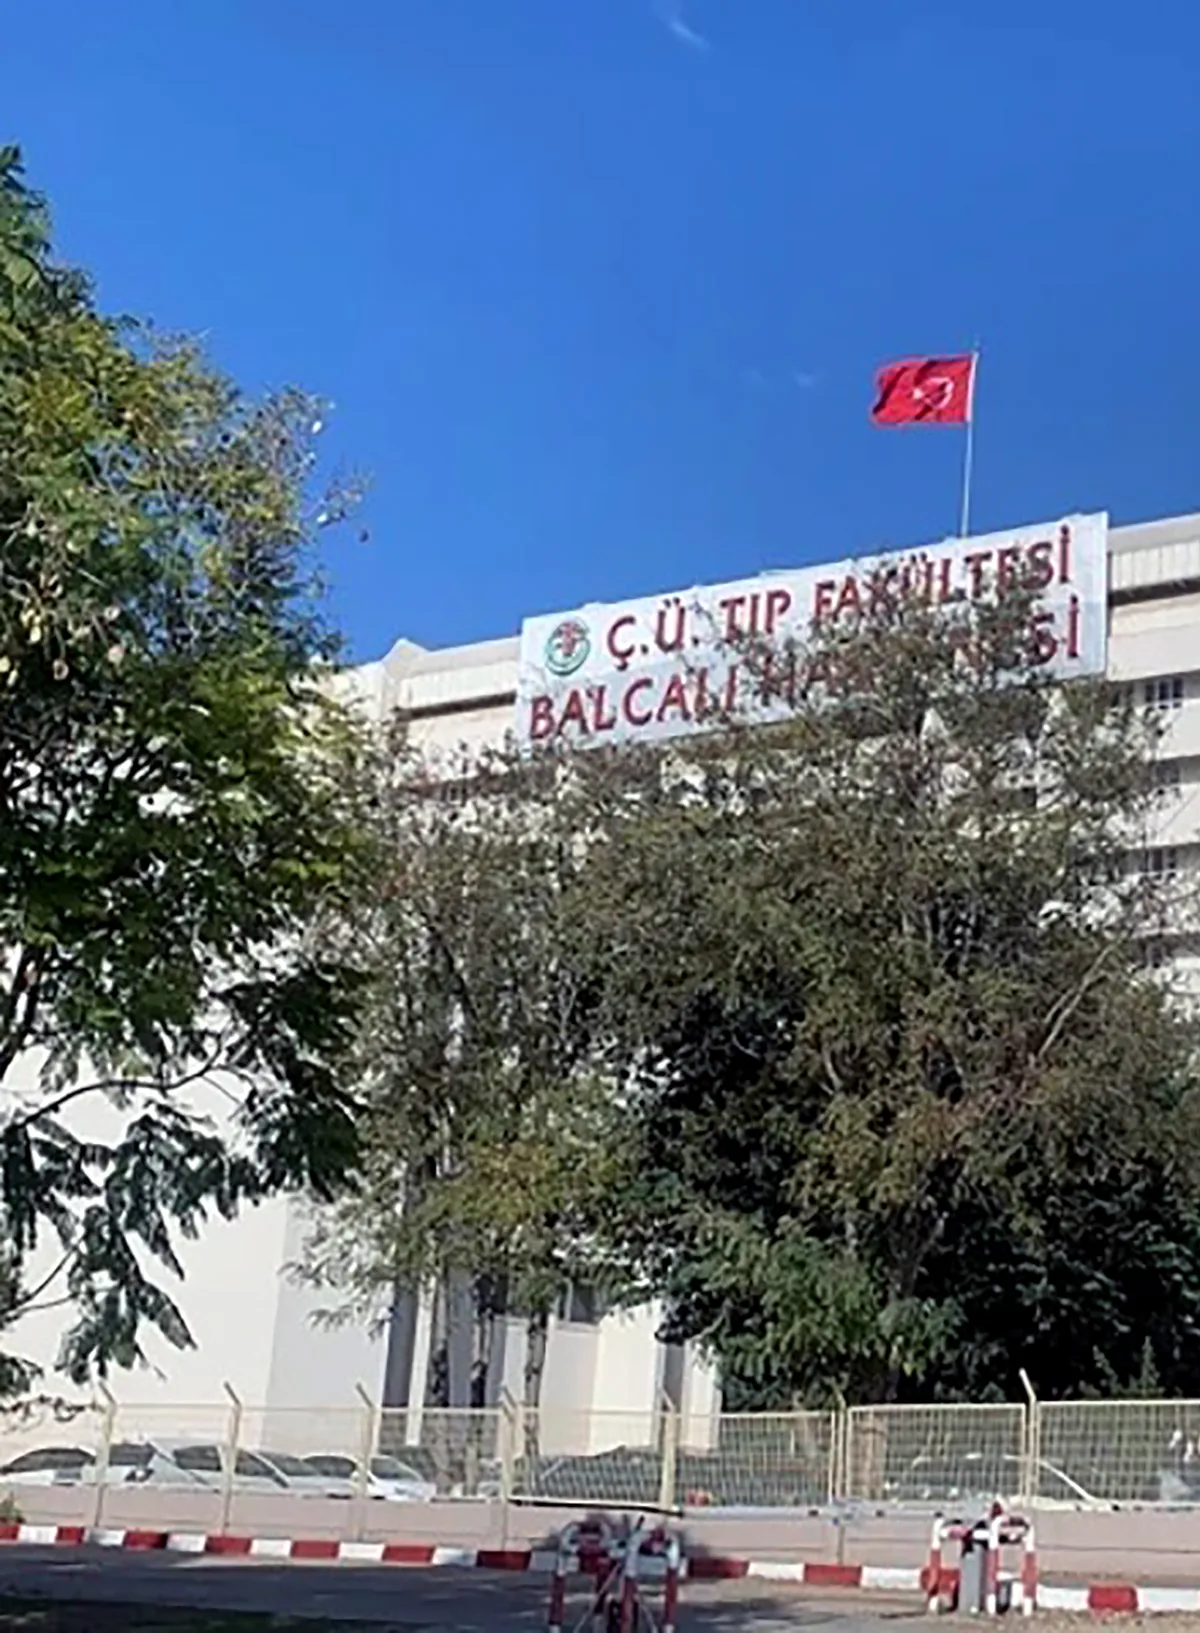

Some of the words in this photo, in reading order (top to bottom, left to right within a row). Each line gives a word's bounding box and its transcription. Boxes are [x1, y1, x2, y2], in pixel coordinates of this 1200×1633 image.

[607, 597, 699, 671] Ç.Ü.
[721, 589, 792, 645] TIP
[813, 524, 1071, 620] FAKÜLTESİ
[529, 664, 738, 740] BALCALI
